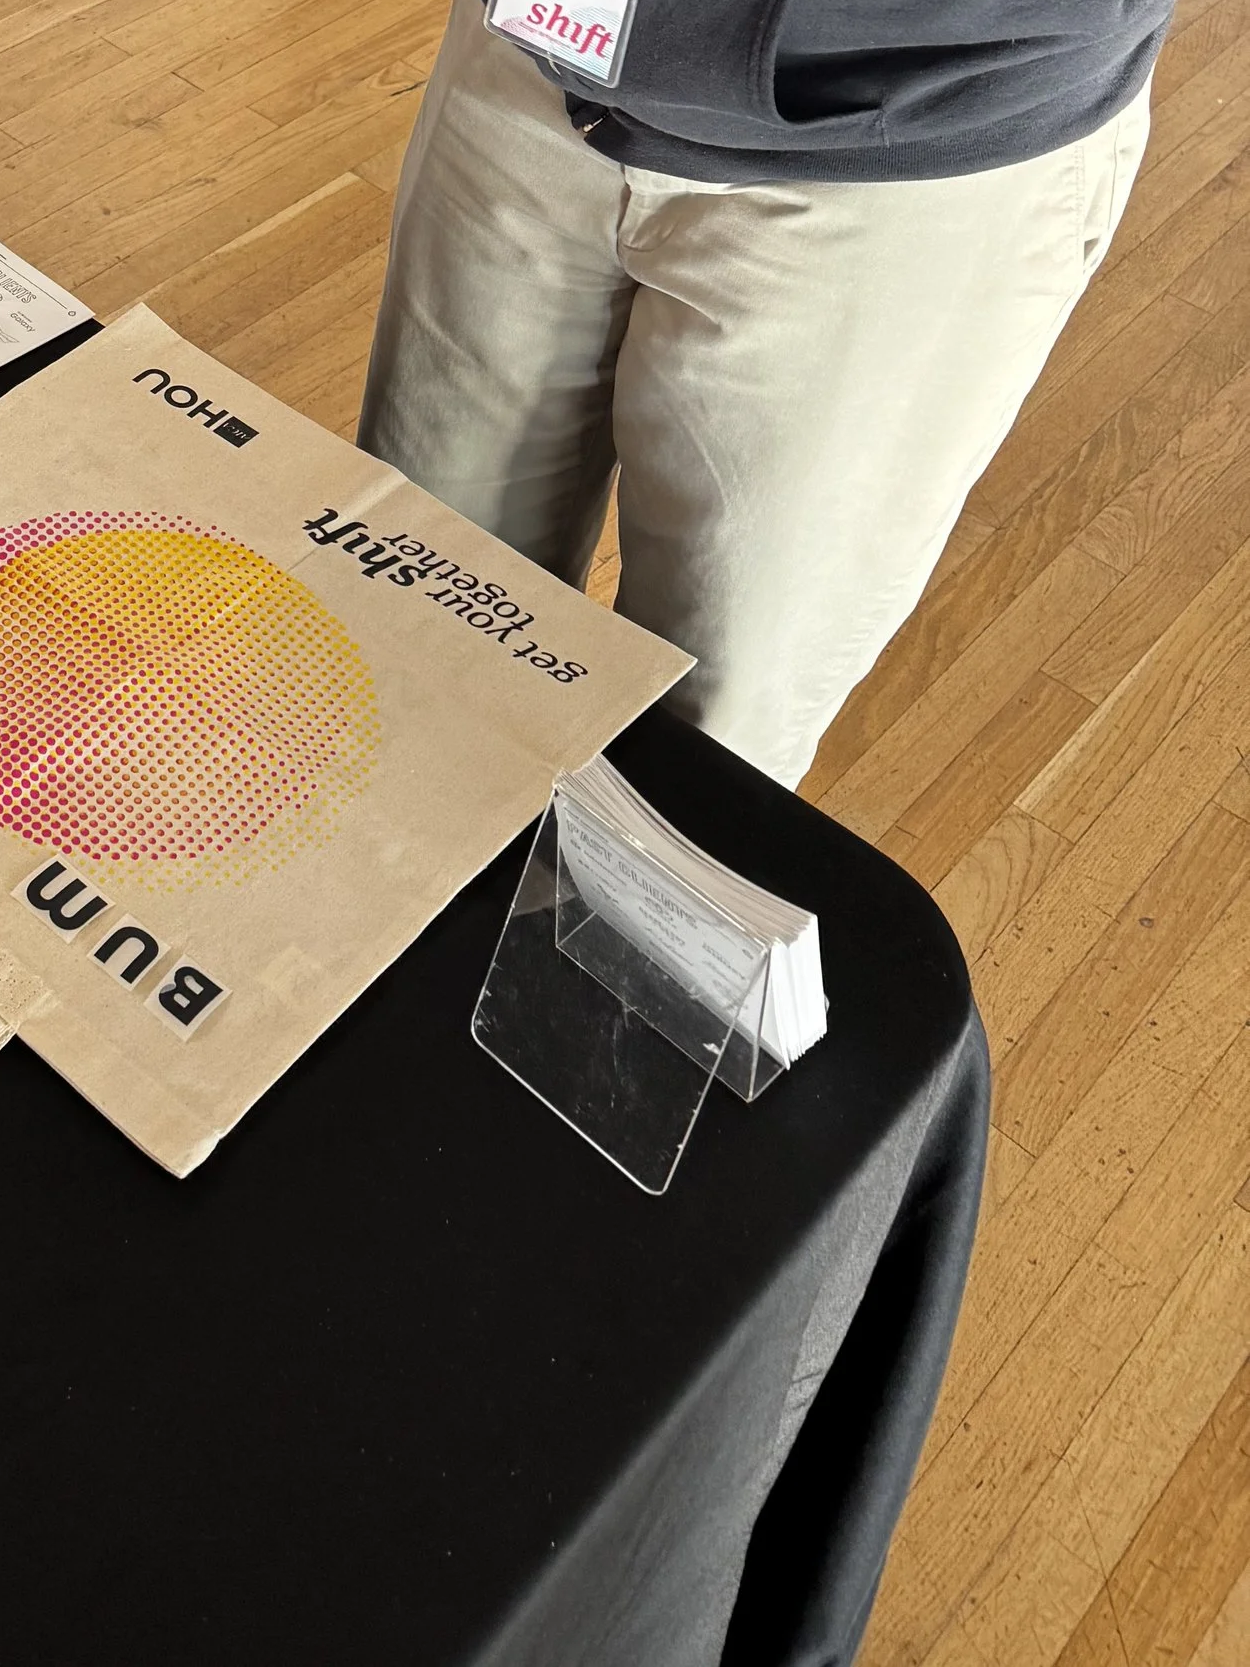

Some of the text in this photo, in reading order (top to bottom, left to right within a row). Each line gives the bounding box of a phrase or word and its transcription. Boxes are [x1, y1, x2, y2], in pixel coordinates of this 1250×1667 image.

[526, 2, 613, 59] shift
[10, 312, 35, 332] Galaxy
[132, 368, 228, 429] HOU
[302, 508, 588, 685] get your shift
[383, 532, 535, 634] together
[26, 860, 224, 1026] BUM
